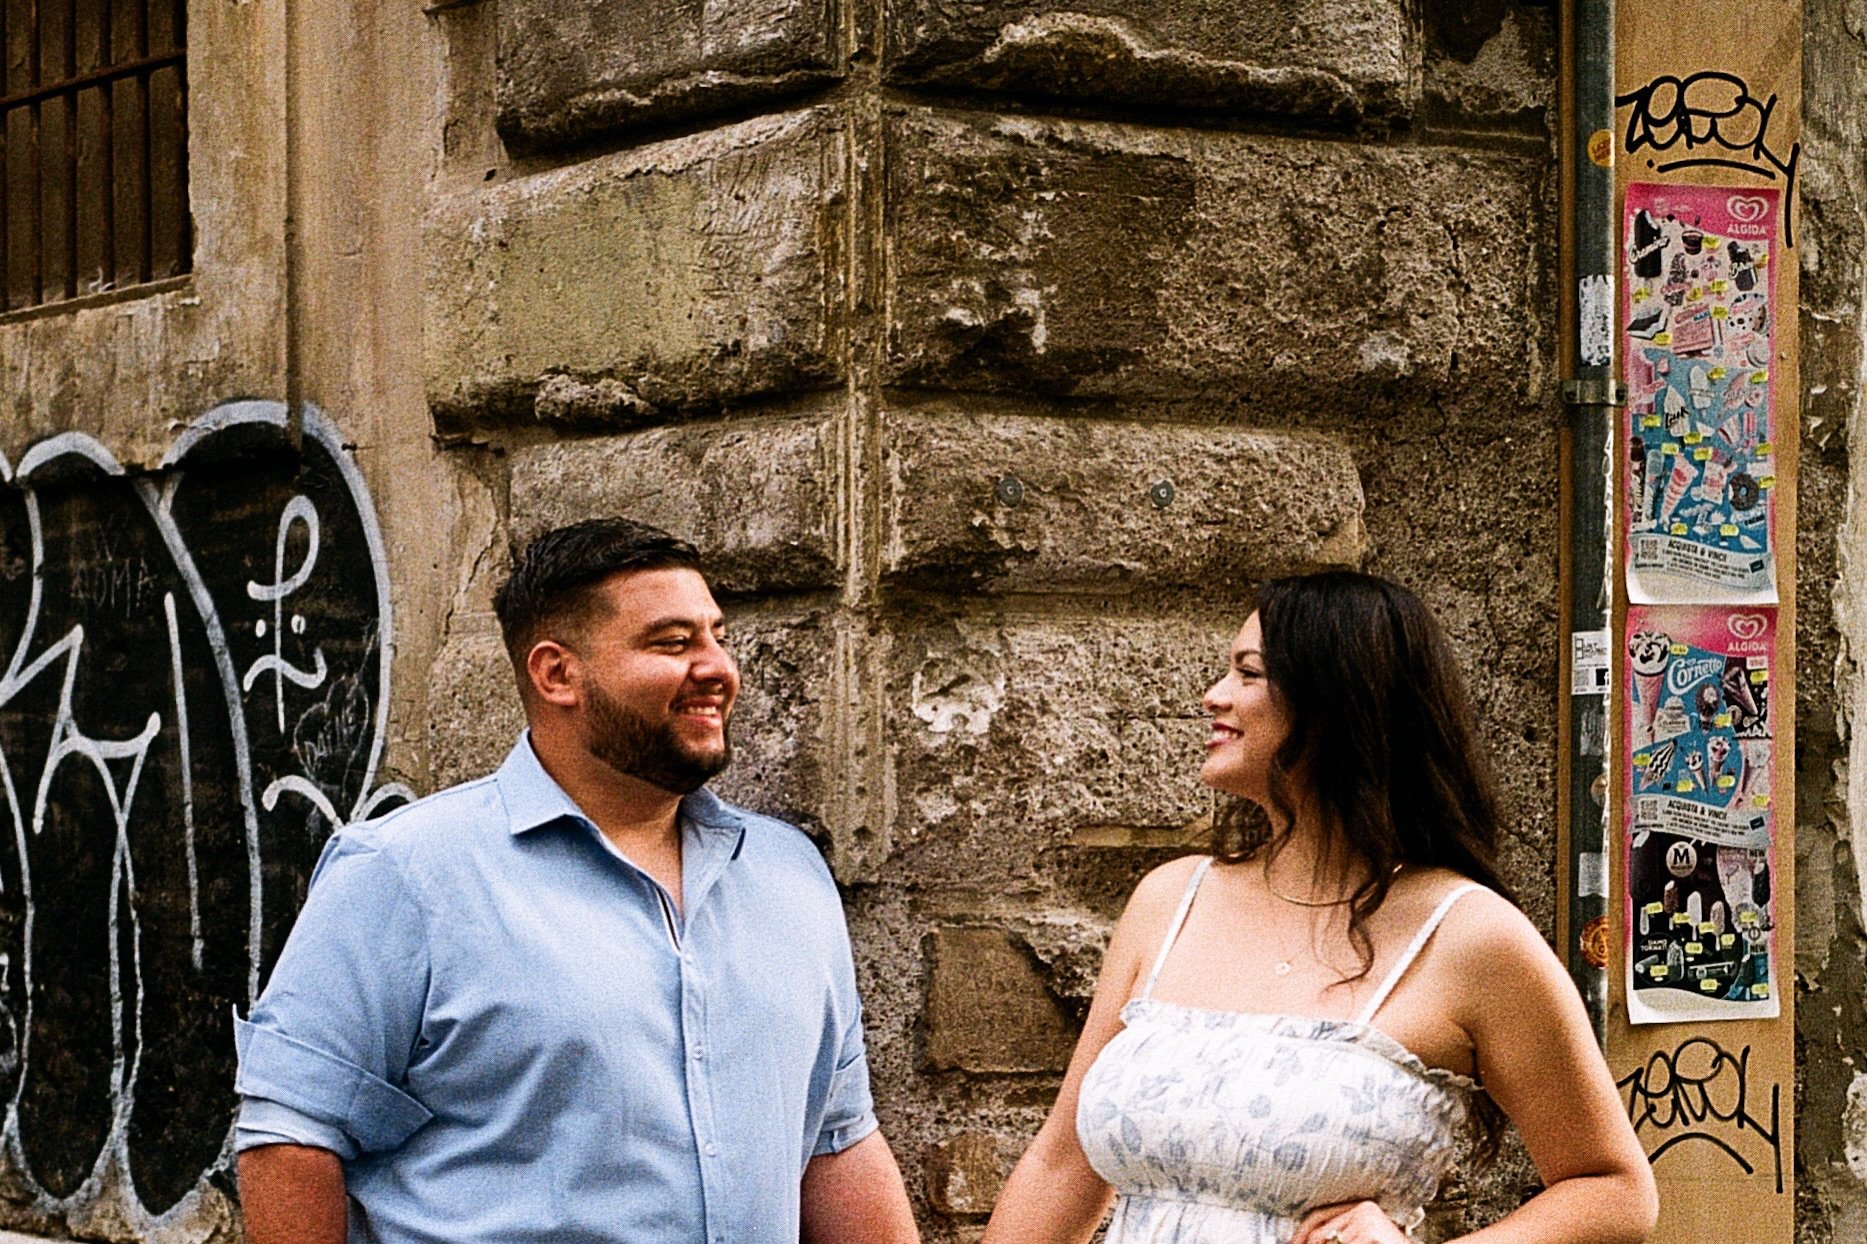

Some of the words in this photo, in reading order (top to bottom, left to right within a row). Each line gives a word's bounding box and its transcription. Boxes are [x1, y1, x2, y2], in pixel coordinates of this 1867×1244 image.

[1727, 224, 1768, 235] ALGIDA
[1727, 642, 1768, 652] ALGIDA
[1667, 657, 1723, 695] Cornetto
[1667, 799, 1698, 814] ACQUISTA
[1673, 847, 1690, 865] M
